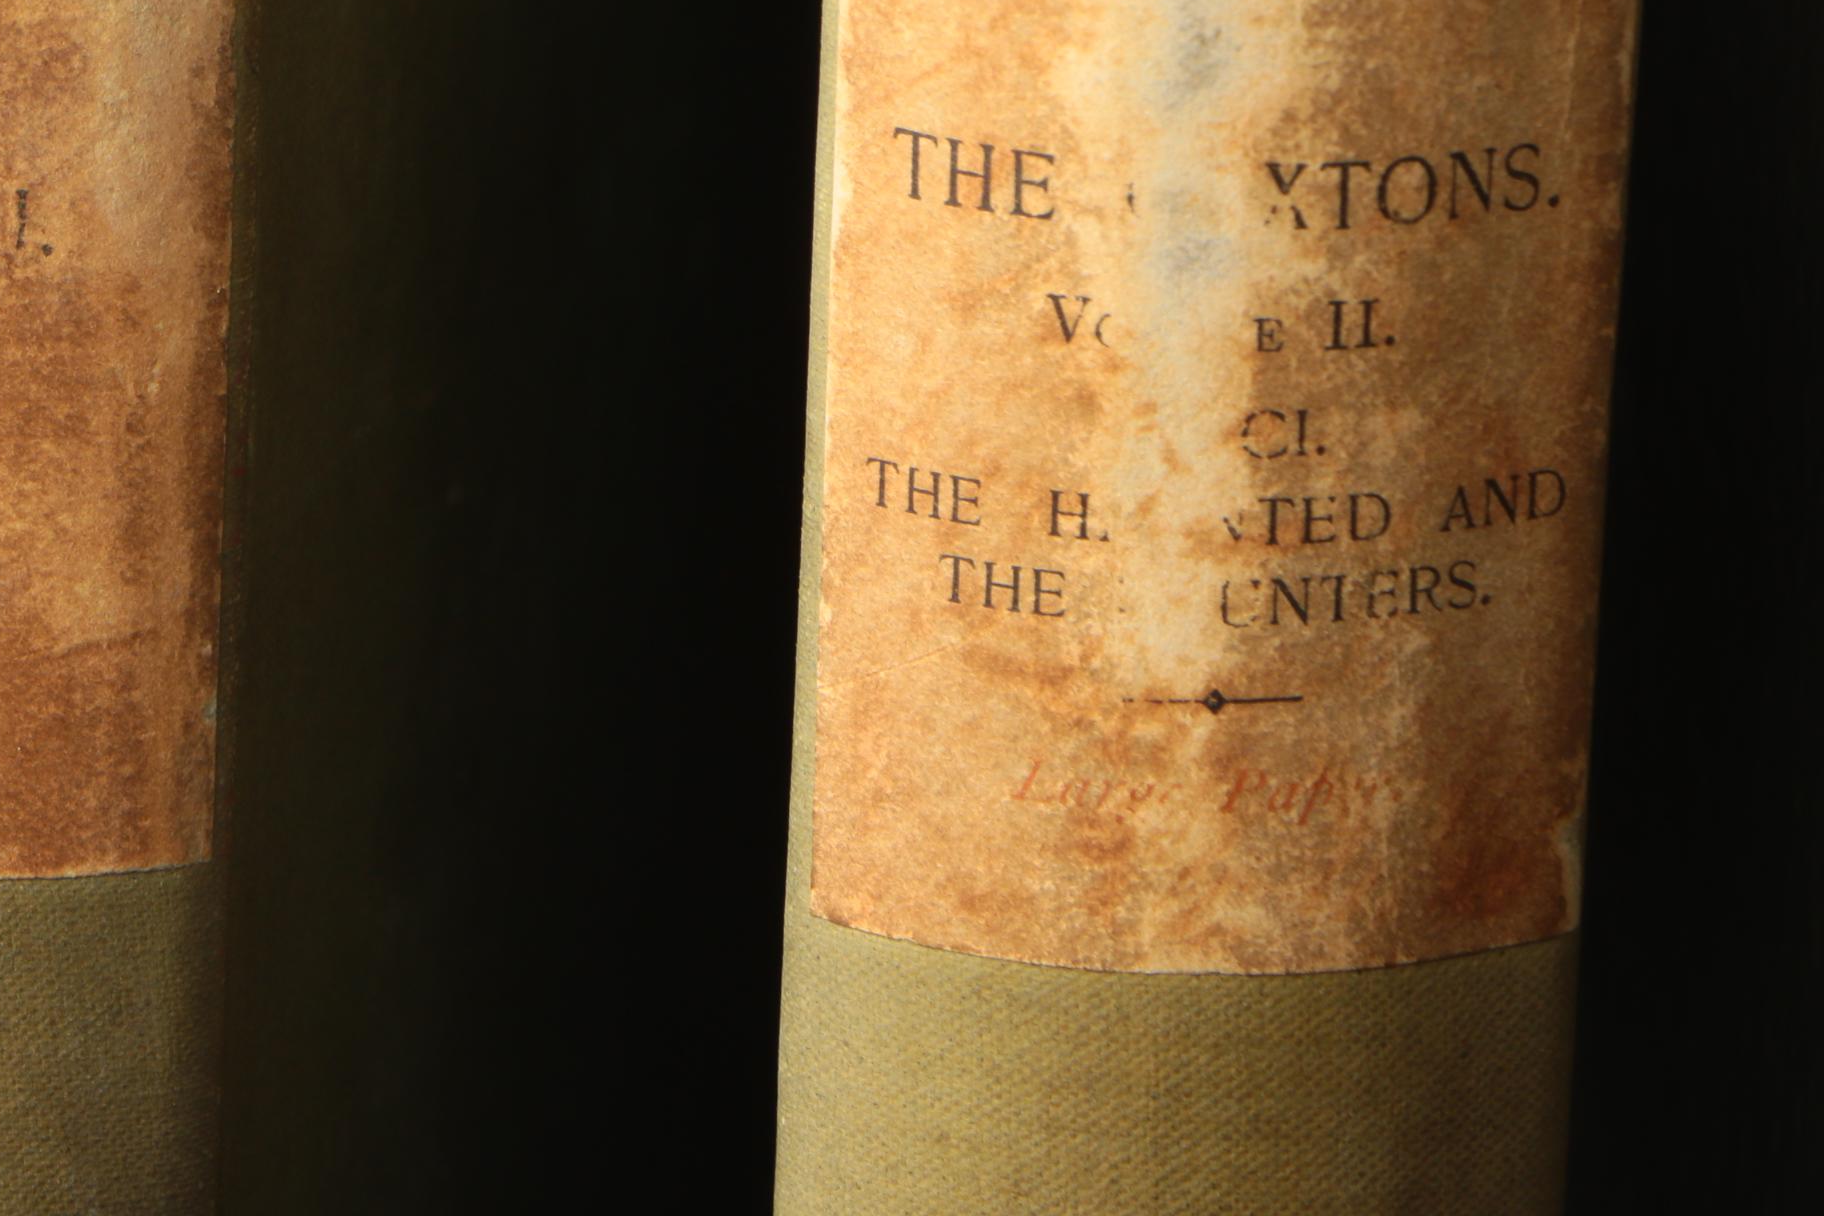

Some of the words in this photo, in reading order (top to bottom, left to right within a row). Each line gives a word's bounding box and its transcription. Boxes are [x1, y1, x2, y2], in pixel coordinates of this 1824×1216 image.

[893, 126, 1056, 221] THE
[1262, 142, 1561, 230] XTONS.
[1324, 297, 1397, 352] II.
[866, 456, 982, 528] THE
[1439, 468, 1567, 533] AND
[938, 552, 1067, 618] THE
[1220, 560, 1492, 629] UNTERS.
